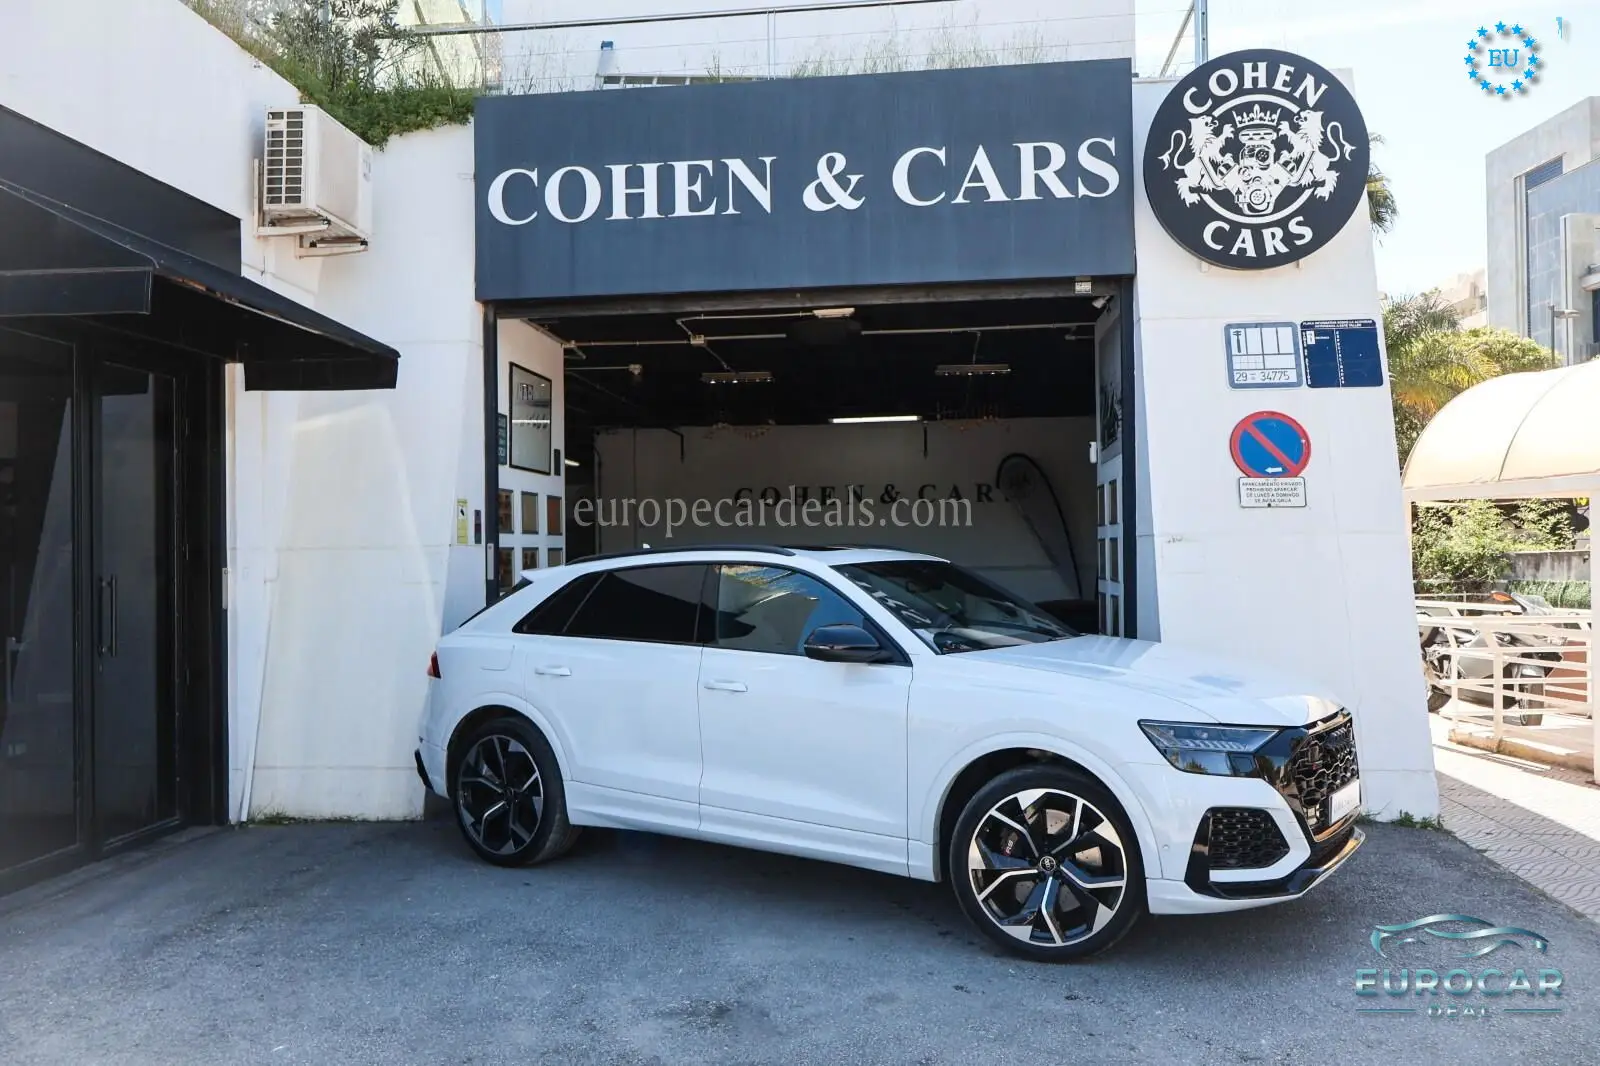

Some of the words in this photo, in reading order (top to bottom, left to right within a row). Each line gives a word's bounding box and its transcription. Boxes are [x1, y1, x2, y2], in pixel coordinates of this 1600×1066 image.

[1183, 61, 1329, 115] COHEN
[487, 156, 778, 226] COHEN
[802, 151, 866, 212] &
[891, 136, 1120, 207] CARS
[1202, 215, 1314, 258] CARS
[1235, 371, 1248, 382] 29
[1259, 370, 1290, 381] 34775
[734, 482, 865, 507] COHEN
[880, 482, 901, 505] &
[918, 482, 1010, 504] CAR
